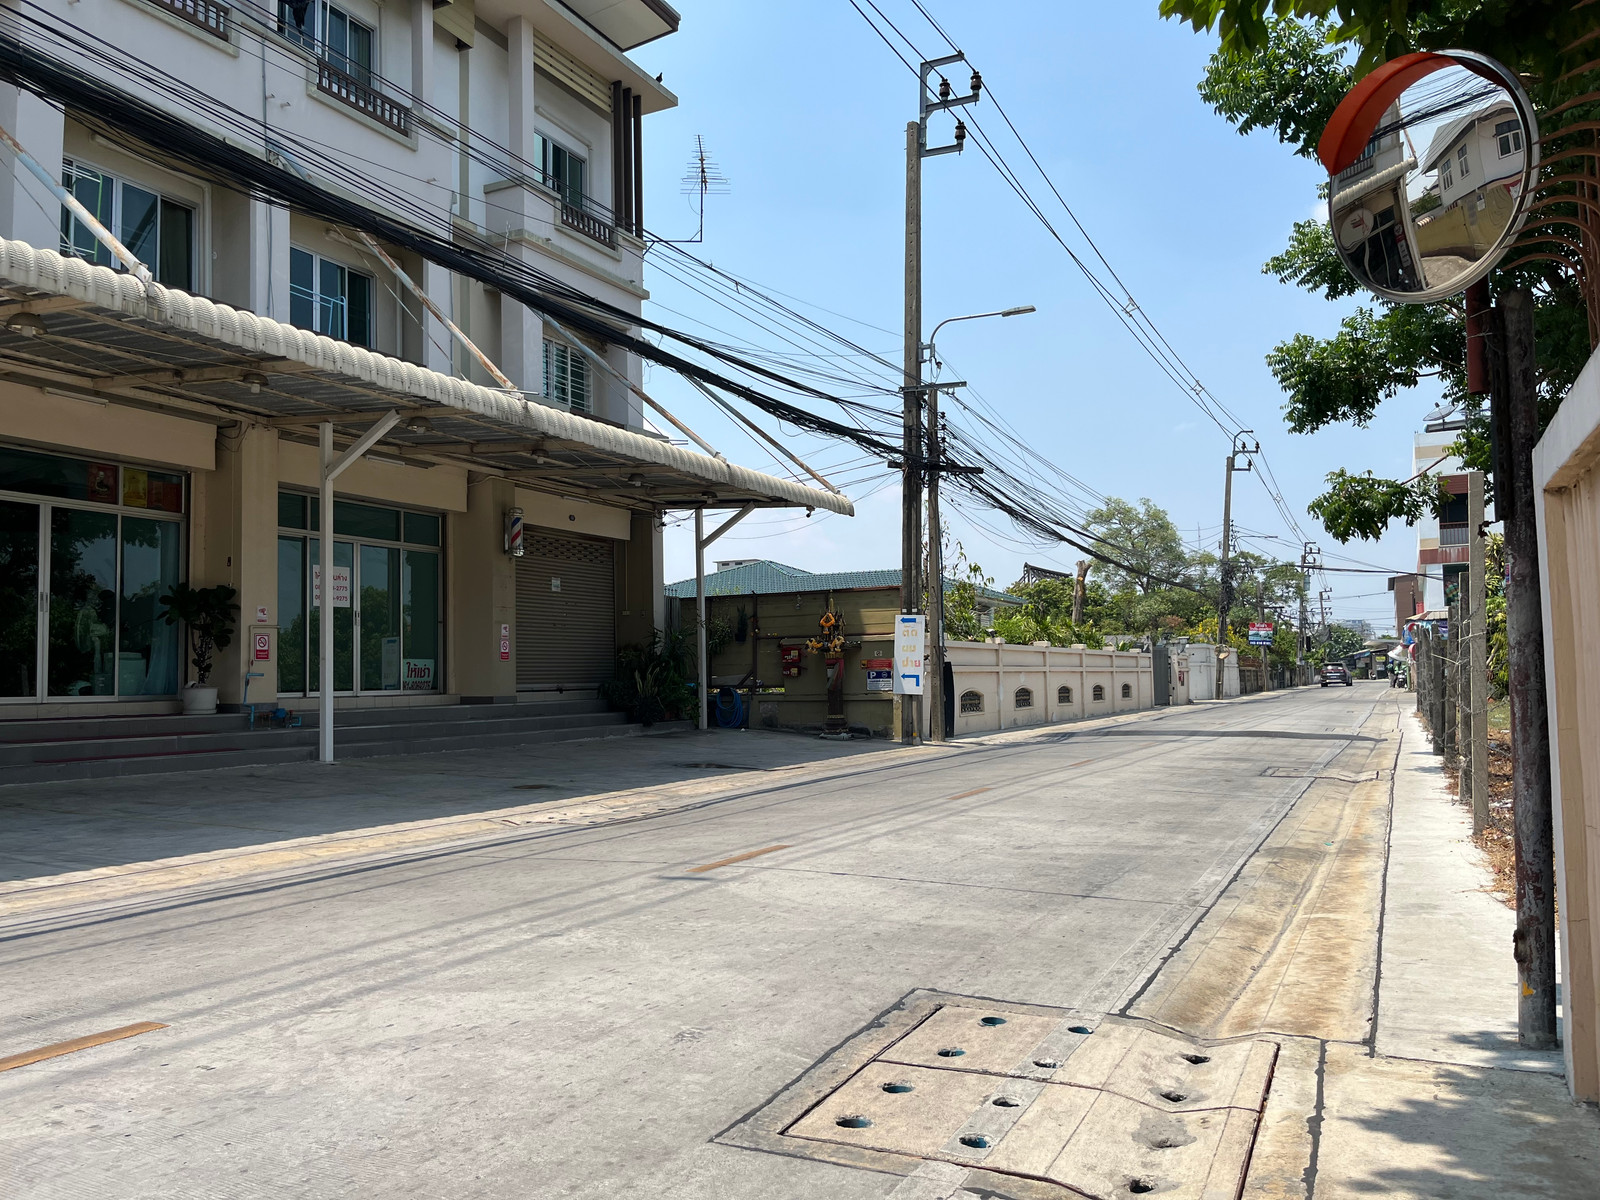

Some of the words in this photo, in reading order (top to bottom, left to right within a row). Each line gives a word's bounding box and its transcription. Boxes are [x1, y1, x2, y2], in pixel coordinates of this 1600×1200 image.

[903, 624, 917, 636] ตัด
[406, 661, 431, 678] ให้เช่า
